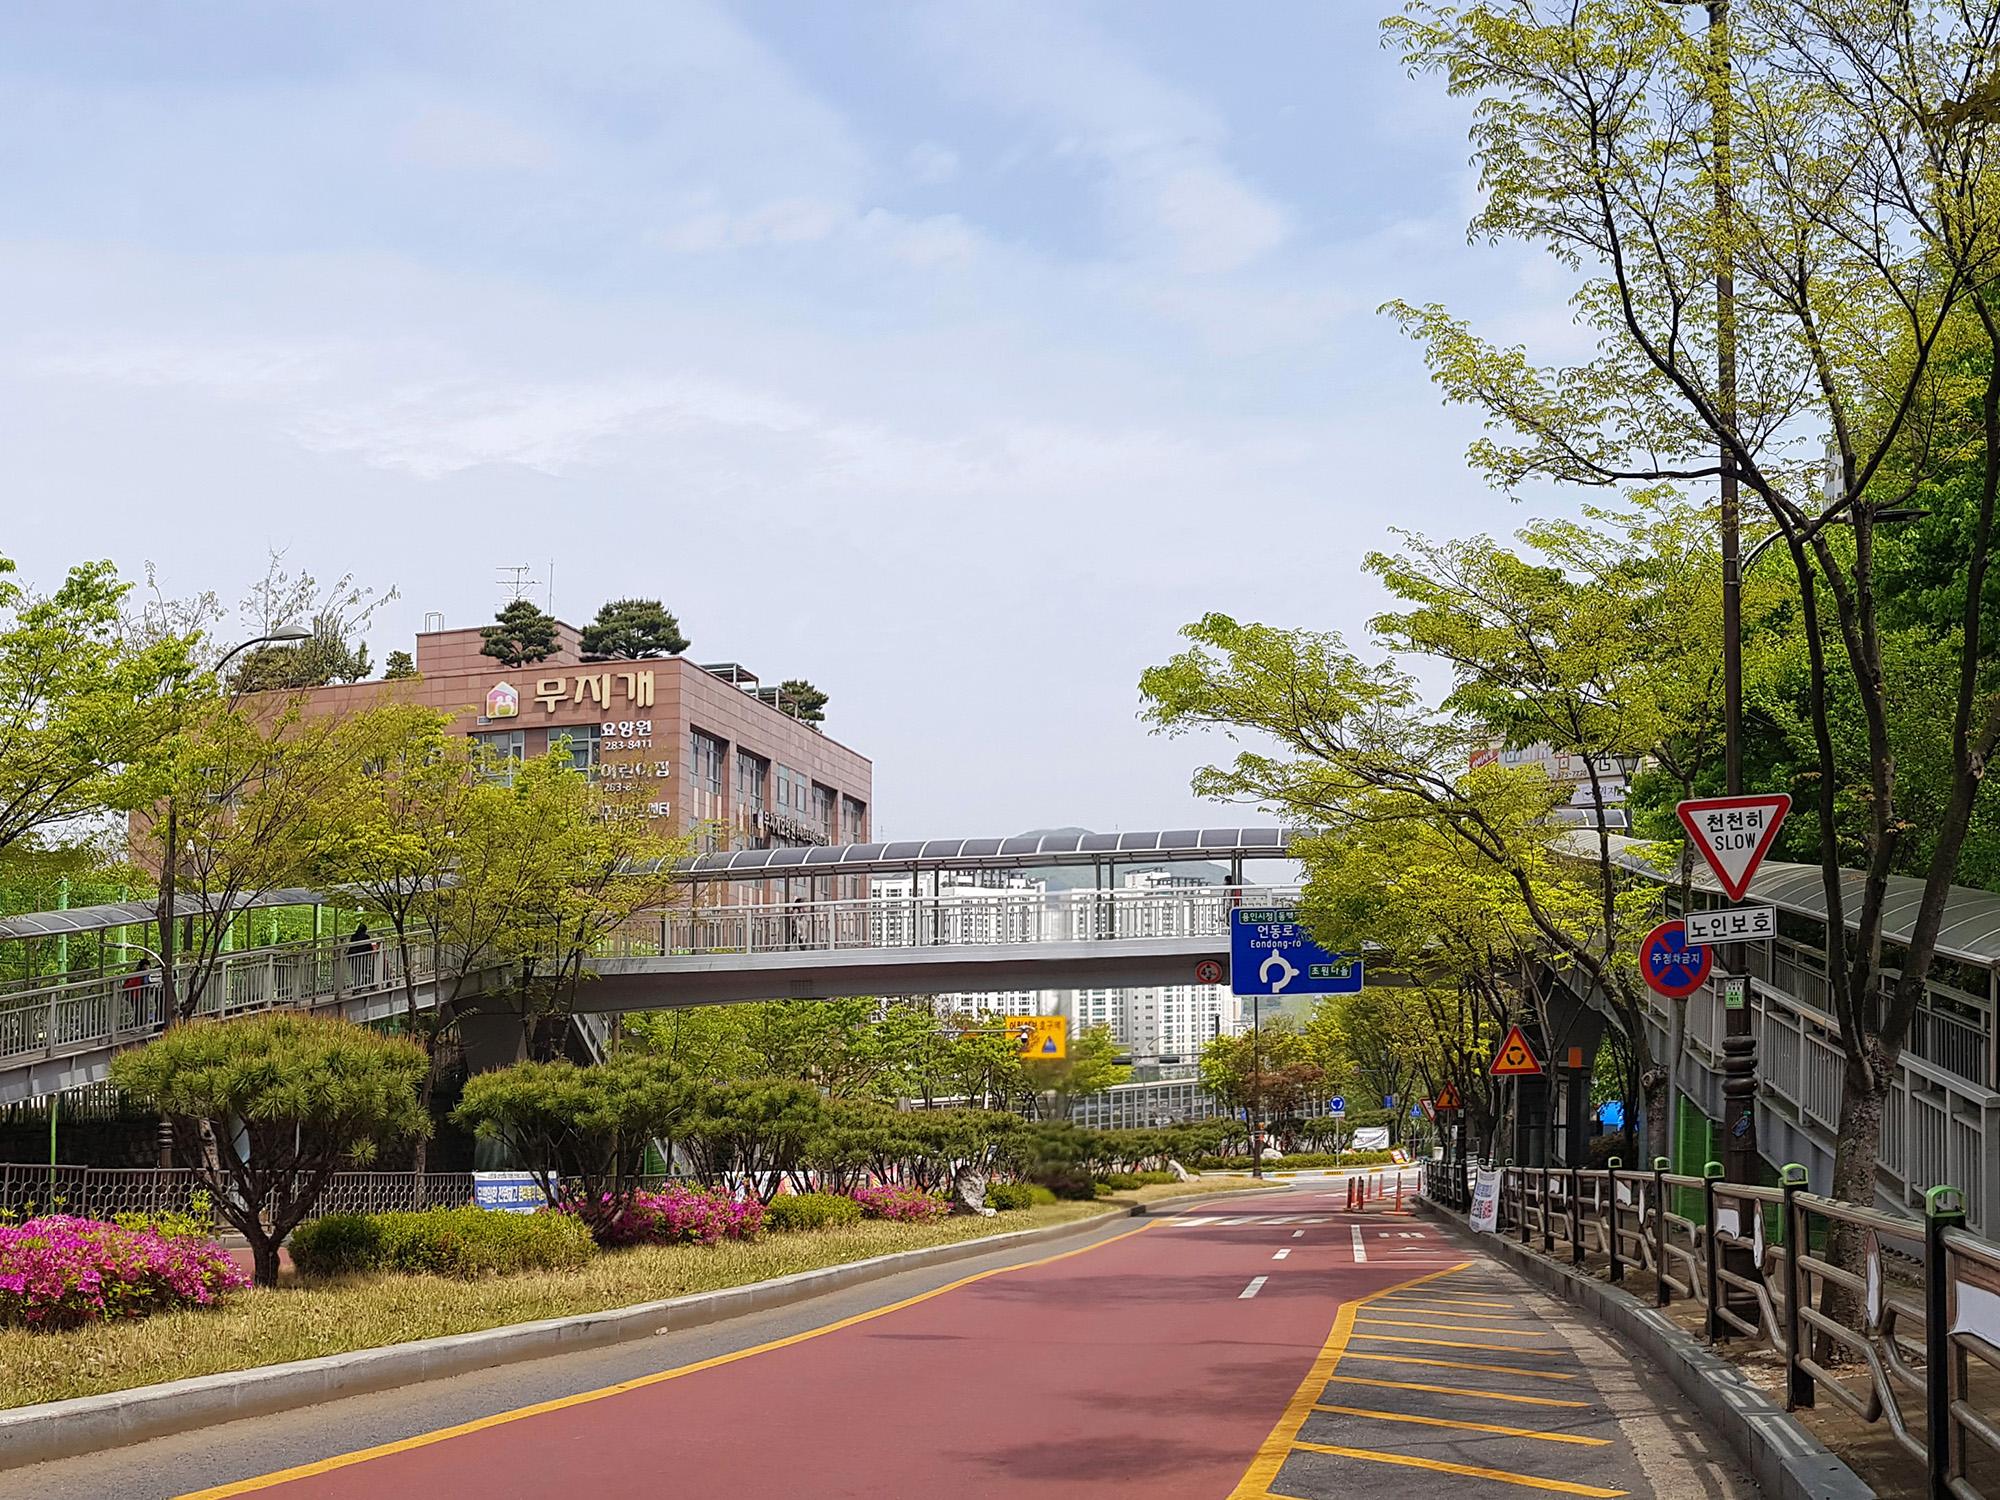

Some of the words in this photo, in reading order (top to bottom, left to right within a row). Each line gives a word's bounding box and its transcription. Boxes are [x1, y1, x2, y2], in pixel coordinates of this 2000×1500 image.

[534, 670, 654, 713] 무지개
[601, 720, 652, 738] 요양원
[605, 740, 652, 750] 283-8411
[1707, 810, 1763, 833] 천천히
[1715, 833, 1756, 851] SLOW
[1242, 912, 1273, 922] 용인시청
[1691, 912, 1771, 938] 노인보호
[1257, 924, 1294, 939] 언동로
[1250, 940, 1302, 949] Eondong-ro
[1652, 952, 1699, 965] 주정차금지
